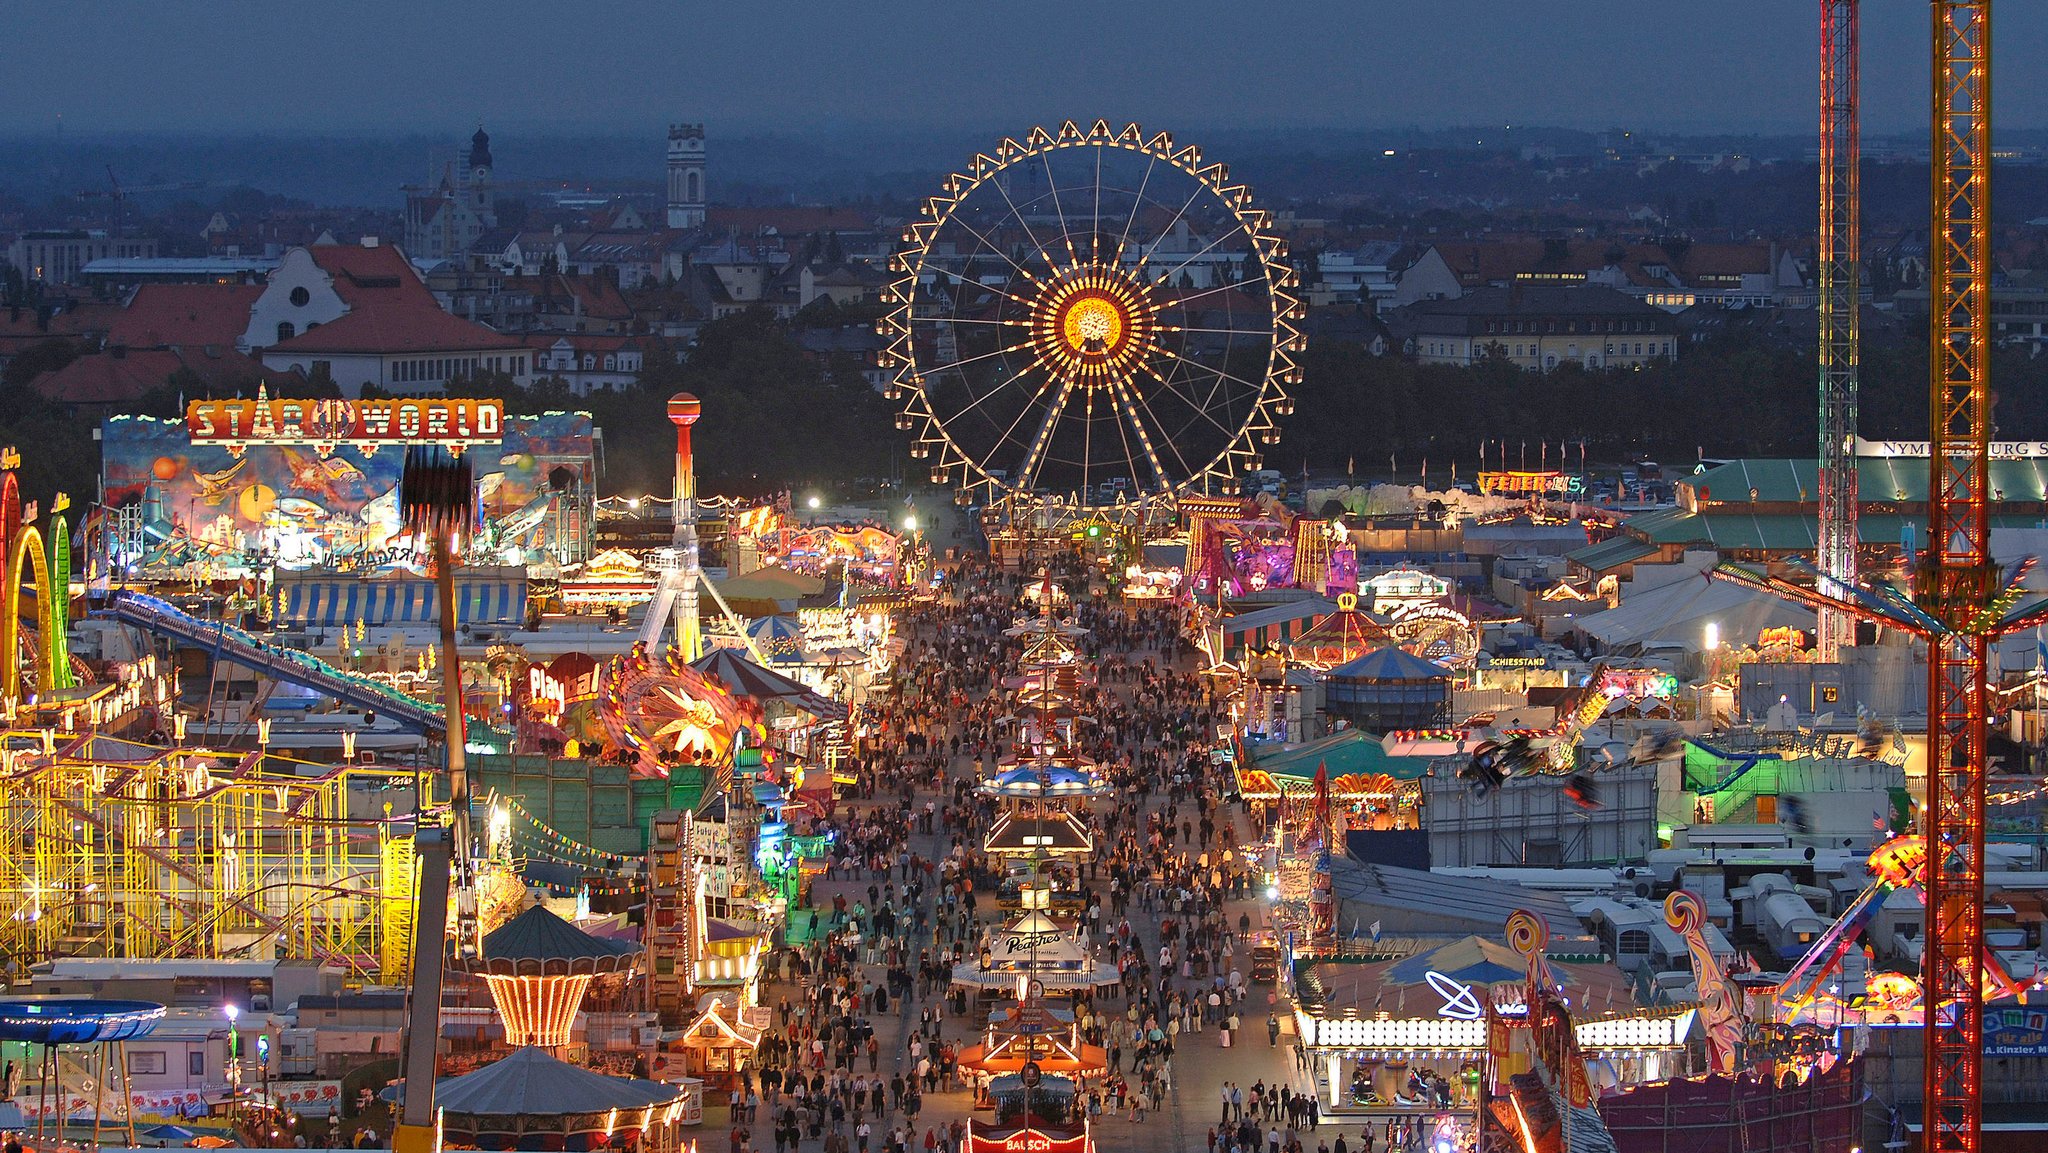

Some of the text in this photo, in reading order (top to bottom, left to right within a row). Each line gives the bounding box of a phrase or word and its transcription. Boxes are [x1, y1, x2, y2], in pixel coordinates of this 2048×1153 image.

[195, 385, 498, 437] STAR WORLD
[2039, 442, 2048, 455] S
[1489, 657, 1545, 666] SCHIESSTAND
[696, 825, 719, 837] Futue
